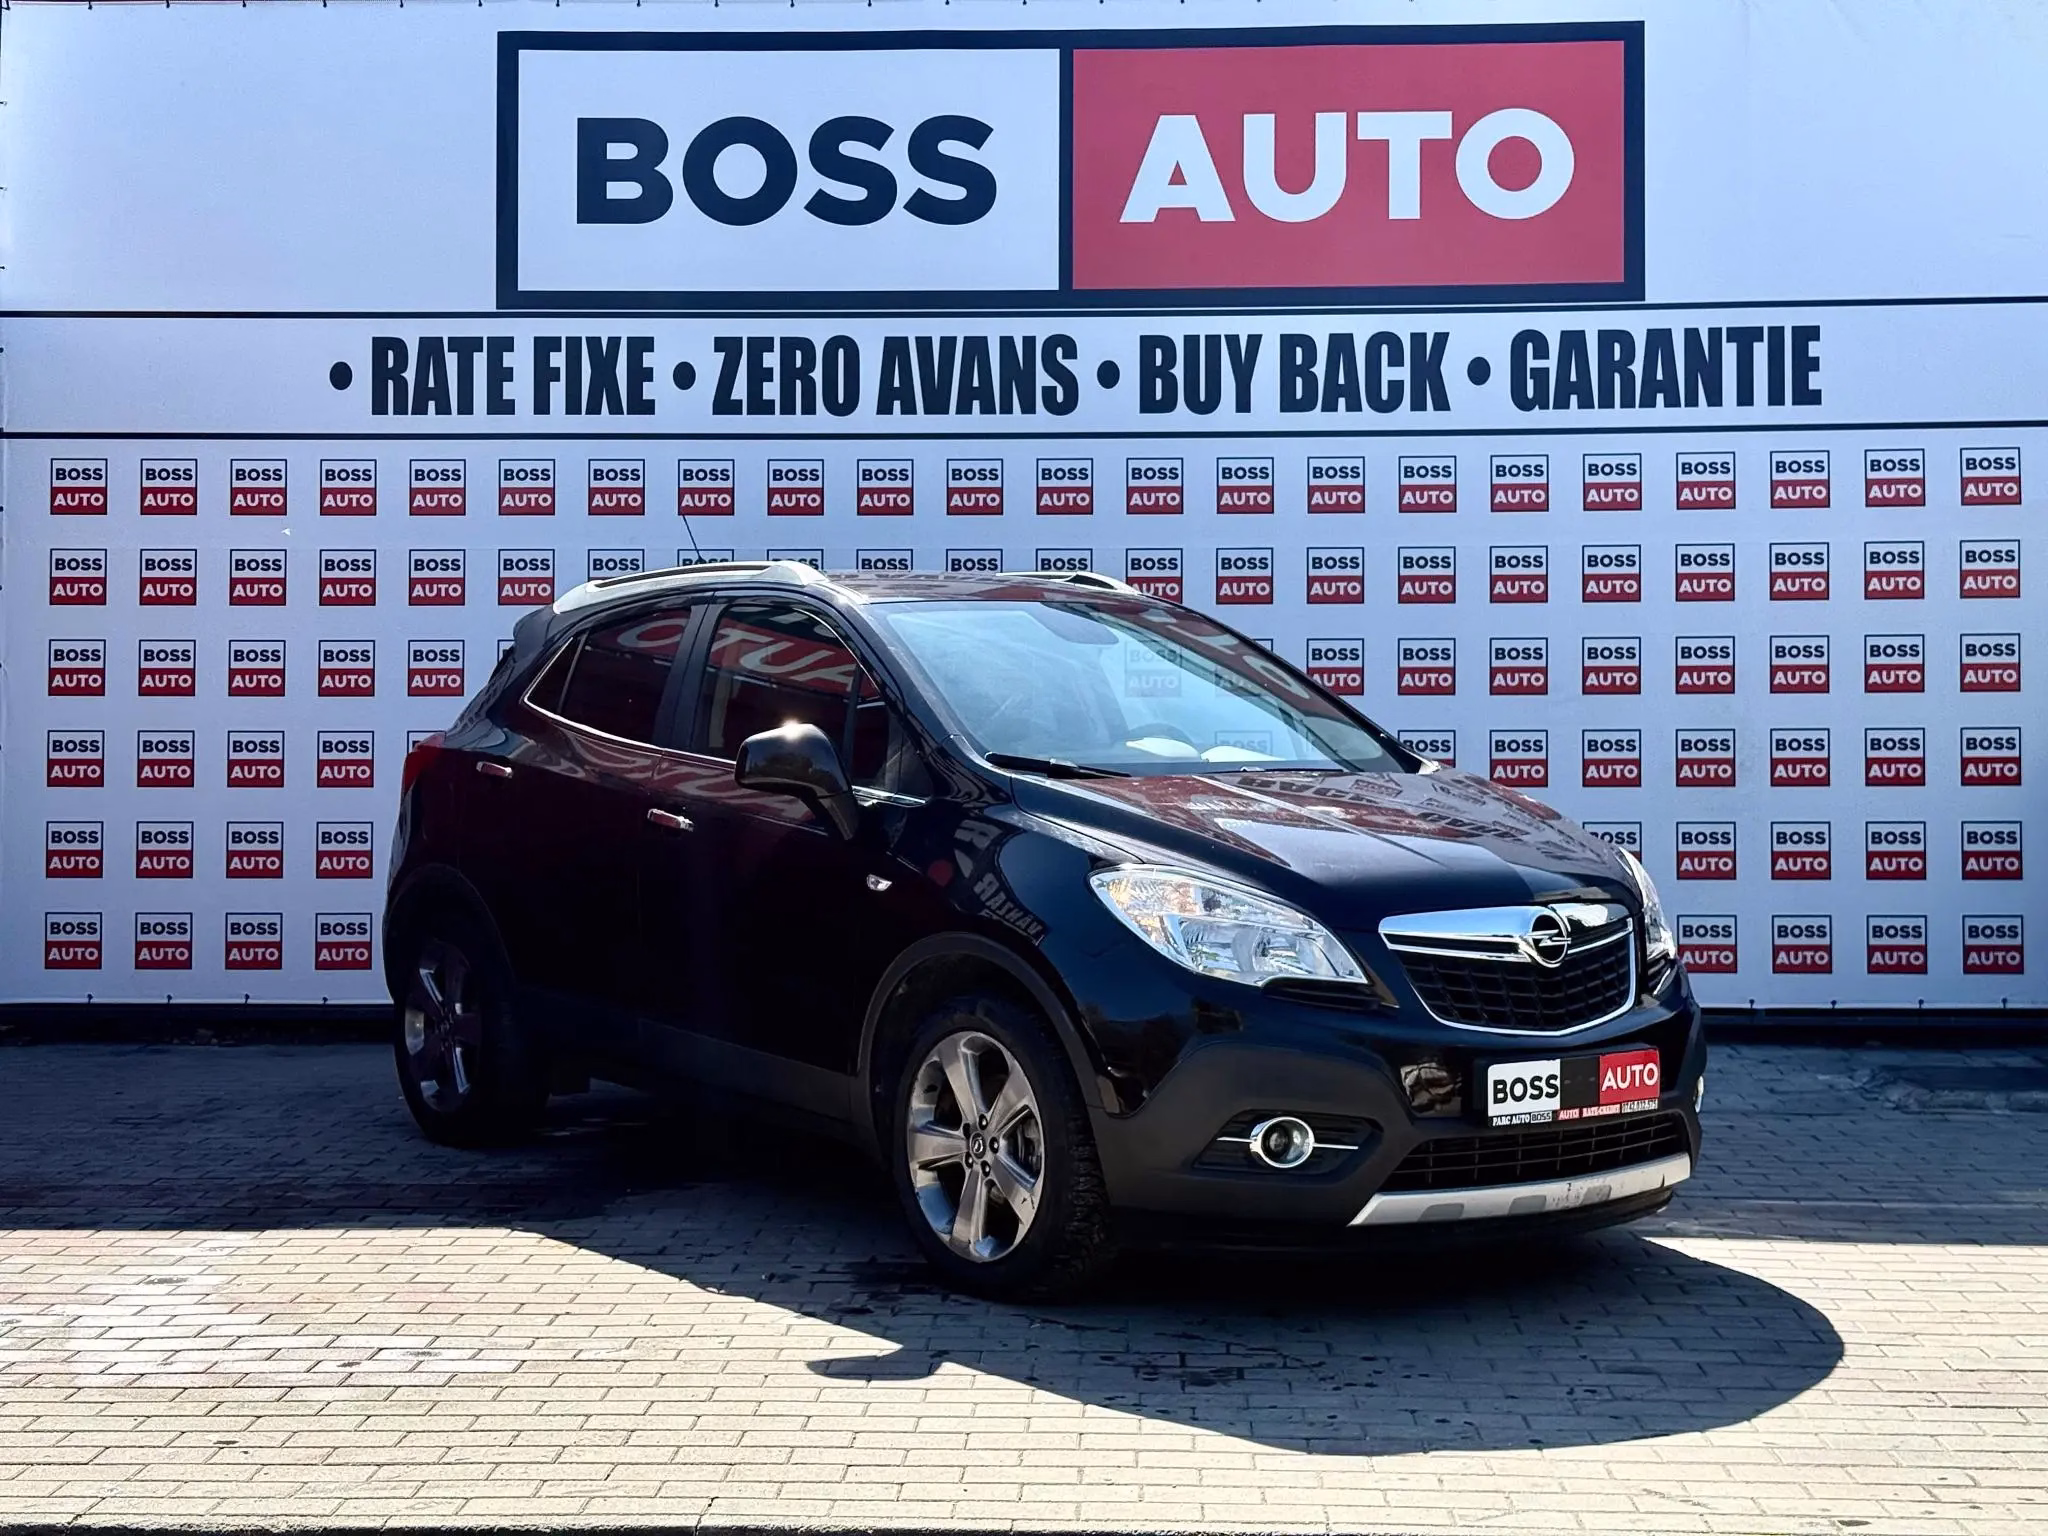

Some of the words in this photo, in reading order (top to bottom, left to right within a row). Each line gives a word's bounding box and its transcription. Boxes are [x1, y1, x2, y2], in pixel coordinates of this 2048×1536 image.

[577, 114, 998, 227] BOSS
[1119, 107, 1575, 224] AUTO
[371, 335, 516, 416] RATE
[533, 335, 656, 416] FIXE
[712, 334, 861, 417] ZERO
[875, 333, 1080, 417] AVANS
[1134, 334, 1263, 416] BUY
[1266, 331, 1452, 414] BACK
[1509, 324, 1823, 412] GARANTIE
[1588, 462, 1637, 477] BOSS
[1775, 459, 1825, 474] BOSS
[1870, 458, 1920, 473] BOSS
[1966, 456, 2016, 471] BOSS
[55, 467, 103, 481] BOSS
[145, 467, 193, 482] BOSS
[324, 468, 373, 482] BOSS
[414, 468, 462, 482] BOSS
[503, 468, 551, 482] BOSS
[593, 468, 641, 482] BOSS
[772, 468, 820, 482] BOSS
[861, 468, 910, 482] BOSS
[951, 468, 999, 482] BOSS
[1041, 467, 1089, 481] BOSS
[1221, 466, 1270, 480] BOSS
[1312, 465, 1361, 480] BOSS
[1403, 465, 1452, 479] BOSS
[1495, 464, 1545, 478] BOSS
[1494, 489, 1546, 504] AUTO
[1586, 488, 1639, 503] AUTO
[1773, 485, 1827, 500] AUTO
[1868, 484, 1923, 499] AUTO
[1964, 482, 2018, 497] AUTO
[54, 493, 104, 507] AUTO
[143, 493, 194, 507] AUTO
[323, 493, 374, 507] AUTO
[412, 493, 463, 507] AUTO
[501, 493, 552, 507] AUTO
[591, 493, 642, 507] AUTO
[770, 493, 821, 507] AUTO
[860, 493, 911, 507] AUTO
[949, 493, 1001, 507] AUTO
[1039, 492, 1090, 506] AUTO
[1220, 491, 1271, 506] AUTO
[1311, 491, 1362, 505] AUTO
[1401, 490, 1454, 505] AUTO
[1041, 557, 1089, 570] BOSS
[1220, 556, 1269, 571] BOSS
[1402, 555, 1452, 570] BOSS
[1494, 555, 1544, 569] BOSS
[1587, 554, 1637, 568] BOSS
[1680, 553, 1730, 567] BOSS
[1870, 550, 1920, 565] BOSS
[1965, 549, 2015, 564] BOSS
[54, 557, 103, 571] BOSS
[234, 558, 283, 572] BOSS
[324, 558, 372, 572] BOSS
[413, 558, 461, 572] BOSS
[502, 558, 551, 572] BOSS
[594, 559, 640, 572] BOSS
[862, 558, 910, 571] BOSS
[951, 558, 998, 571] BOSS
[1130, 557, 1179, 571] BOSS
[1219, 582, 1271, 596] AUTO
[1401, 581, 1453, 595] AUTO
[1493, 580, 1545, 595] AUTO
[1585, 579, 1638, 594] AUTO
[1678, 578, 1732, 593] AUTO
[1868, 576, 1921, 591] AUTO
[1963, 575, 2017, 590] AUTO
[53, 583, 104, 597] AUTO
[232, 583, 283, 597] AUTO
[322, 583, 373, 597] AUTO
[411, 583, 462, 597] AUTO
[501, 583, 552, 597] AUTO
[53, 648, 102, 662] BOSS
[143, 648, 192, 662] BOSS
[323, 649, 371, 663] BOSS
[412, 649, 461, 663] BOSS
[1311, 647, 1360, 661] BOSS
[1402, 647, 1452, 661] BOSS
[1494, 647, 1544, 661] BOSS
[1680, 645, 1730, 660] BOSS
[1775, 644, 1825, 659] BOSS
[1870, 644, 1920, 658] BOSS
[1966, 643, 2016, 657] BOSS
[51, 674, 102, 688] AUTO
[141, 674, 192, 688] AUTO
[321, 674, 372, 688] AUTO
[411, 674, 461, 688] AUTO
[1400, 673, 1453, 687] AUTO
[1493, 672, 1545, 687] AUTO
[1679, 671, 1732, 686] AUTO
[1773, 670, 1826, 685] AUTO
[1868, 669, 1922, 684] AUTO
[1964, 669, 2017, 684] AUTO
[142, 739, 191, 753] BOSS
[232, 739, 280, 754] BOSS
[322, 740, 370, 754] BOSS
[1494, 739, 1544, 753] BOSS
[1587, 738, 1637, 753] BOSS
[1681, 738, 1731, 752] BOSS
[1870, 737, 1920, 751] BOSS
[1966, 736, 2016, 751] BOSS
[140, 765, 191, 779] AUTO
[230, 765, 281, 779] AUTO
[320, 765, 371, 779] AUTO
[1493, 765, 1545, 778] AUTO
[1585, 764, 1638, 779] AUTO
[1679, 764, 1732, 778] AUTO
[1868, 763, 1922, 778] AUTO
[1964, 763, 2018, 777] AUTO
[50, 830, 99, 844] BOSS
[141, 830, 190, 845] BOSS
[321, 830, 369, 845] BOSS
[1681, 831, 1731, 845] BOSS
[1776, 831, 1826, 845] BOSS
[1871, 831, 1921, 845] BOSS
[49, 856, 100, 870] AUTO
[139, 856, 190, 870] AUTO
[319, 856, 370, 870] AUTO
[1679, 857, 1733, 872] AUTO
[1774, 857, 1828, 872] AUTO
[1869, 857, 1923, 872] AUTO
[49, 921, 98, 936] BOSS
[140, 921, 189, 936] BOSS
[230, 922, 278, 936] BOSS
[320, 922, 368, 936] BOSS
[1682, 924, 1732, 939] BOSS
[1872, 924, 1922, 939] BOSS
[1969, 924, 2019, 939] BOSS
[48, 947, 99, 961] AUTO
[138, 947, 189, 961] AUTO
[228, 947, 279, 961] AUTO
[318, 947, 369, 962] AUTO
[1680, 950, 1734, 965] AUTO
[1870, 951, 1924, 965] AUTO
[1967, 951, 2021, 966] AUTO
[1493, 1074, 1559, 1104] BOSS
[1601, 1063, 1659, 1092] AUTO
[1493, 1114, 1511, 1127] PARC
[1512, 1113, 1530, 1125] AUTO
[1532, 1111, 1551, 1122] BOSS
